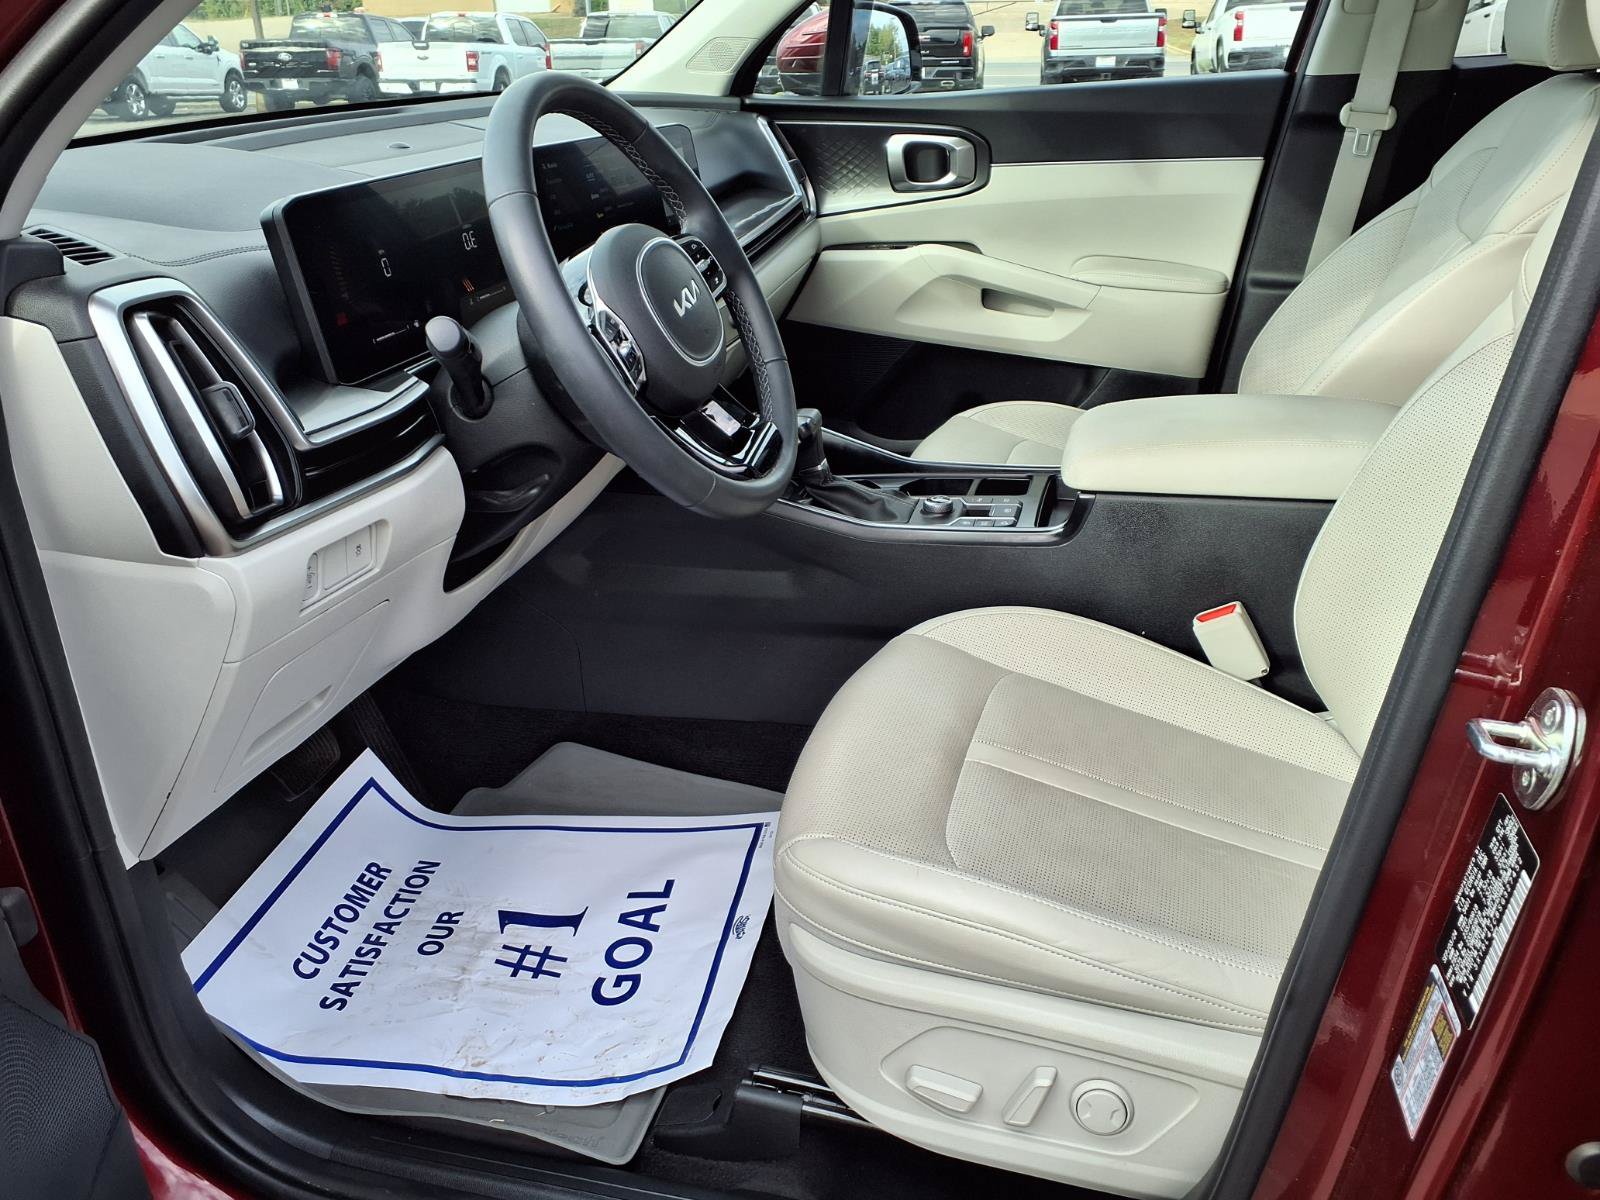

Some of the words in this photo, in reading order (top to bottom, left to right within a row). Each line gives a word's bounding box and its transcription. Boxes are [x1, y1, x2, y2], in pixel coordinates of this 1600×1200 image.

[673, 279, 700, 317] KIA
[292, 861, 393, 980] CUSTOMER
[319, 860, 441, 1011] SATISFACTION
[417, 911, 464, 956] OUR
[494, 906, 589, 980] #1
[591, 879, 675, 1006] GOAL
